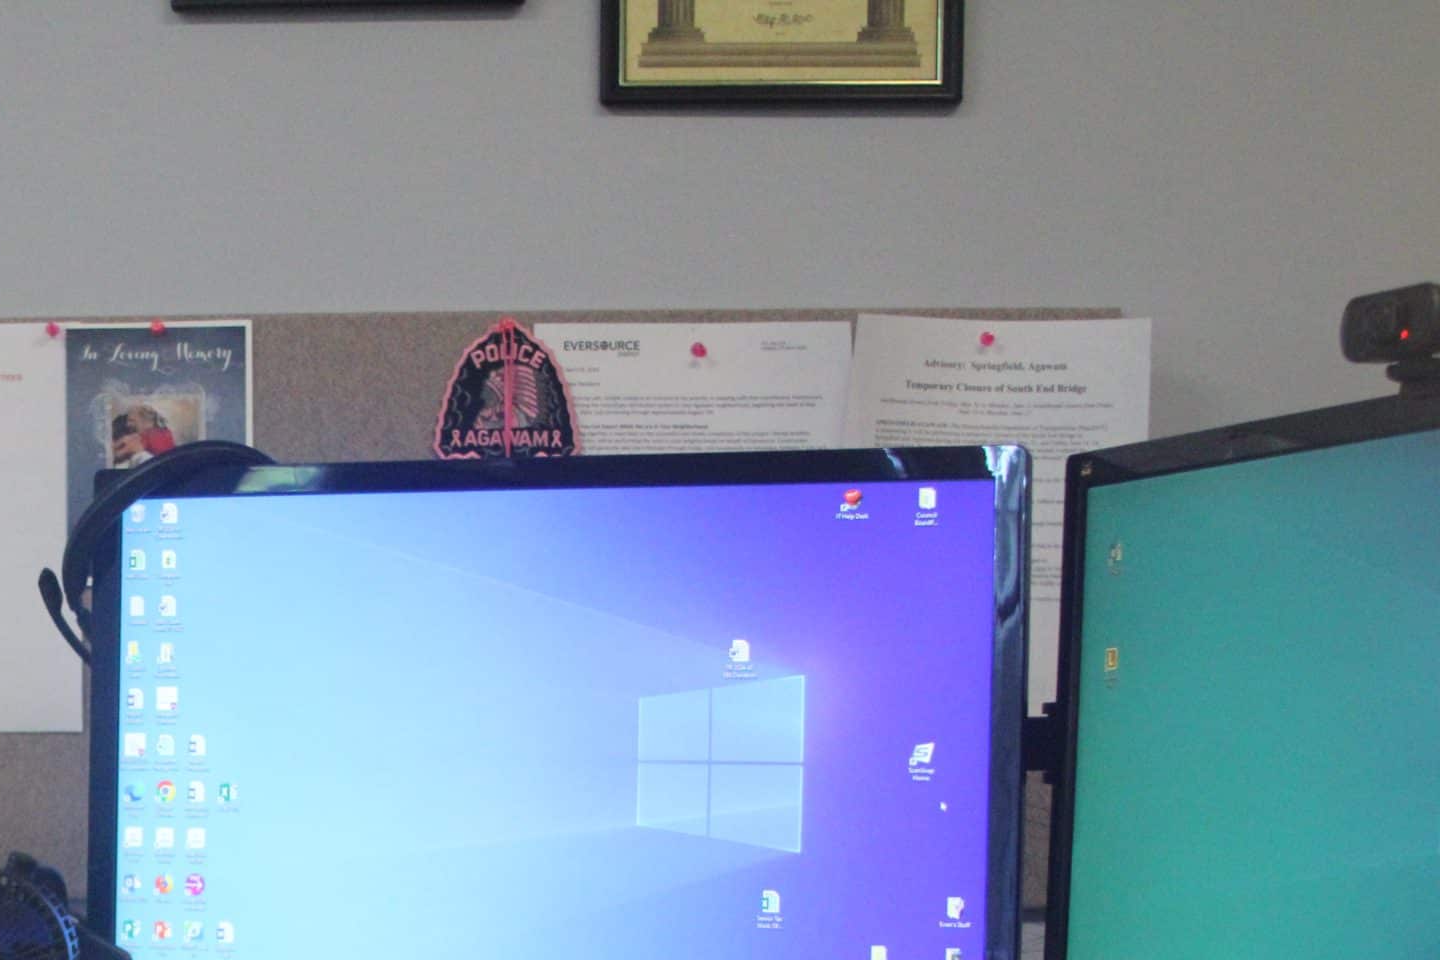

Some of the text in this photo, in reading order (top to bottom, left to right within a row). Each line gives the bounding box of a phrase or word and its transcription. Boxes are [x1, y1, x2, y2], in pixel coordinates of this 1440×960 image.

[563, 341, 640, 351] EVERSOURCE
[81, 342, 233, 372] In Loving Memory
[470, 343, 546, 369] POLICE
[924, 358, 1067, 374] Advisory: Springfield, Agawam
[905, 380, 954, 393] Temporary
[956, 381, 996, 393] Closure
[1006, 383, 1034, 393] South
[1036, 383, 1055, 393] End
[1057, 383, 1087, 396] Bridge
[464, 430, 549, 447] AGAWAM
